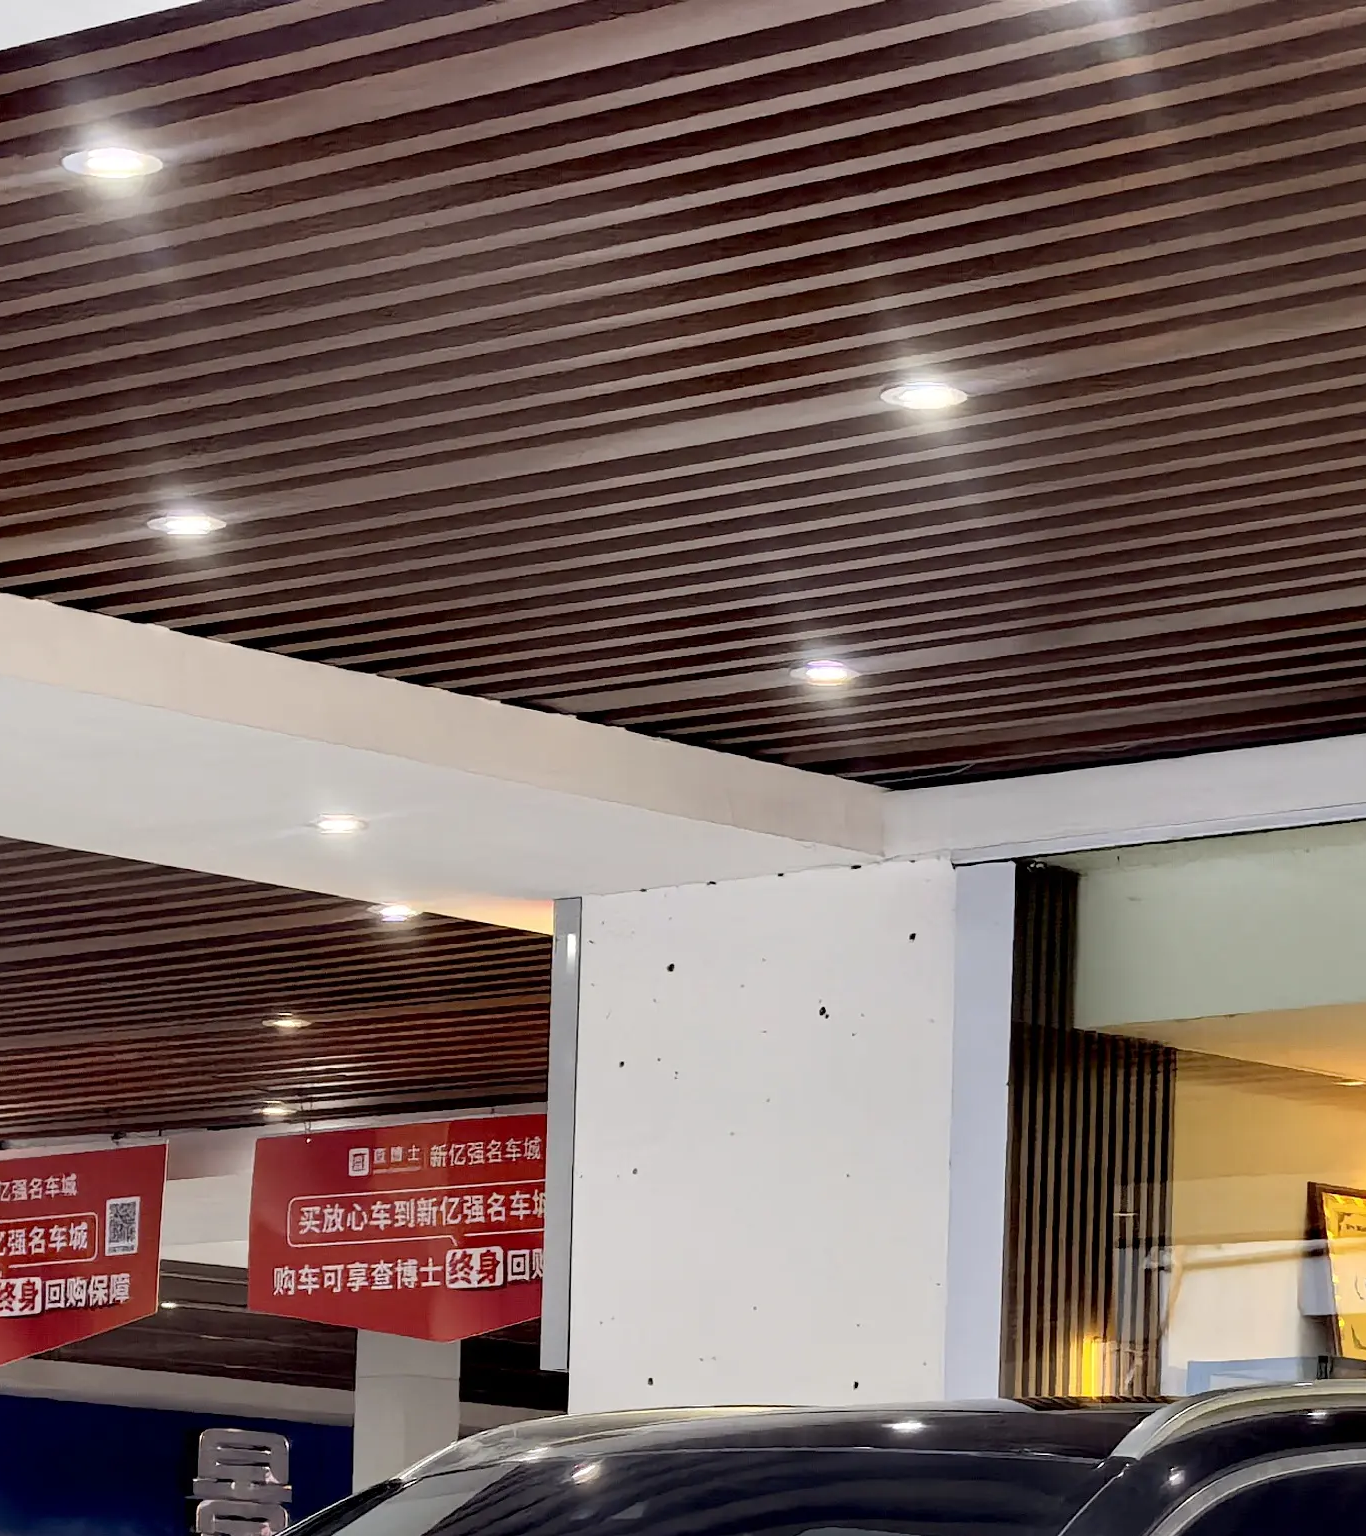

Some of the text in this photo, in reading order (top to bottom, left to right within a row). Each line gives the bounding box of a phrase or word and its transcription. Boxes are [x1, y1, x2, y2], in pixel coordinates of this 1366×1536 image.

[430, 1135, 541, 1168] 新亿强名车城
